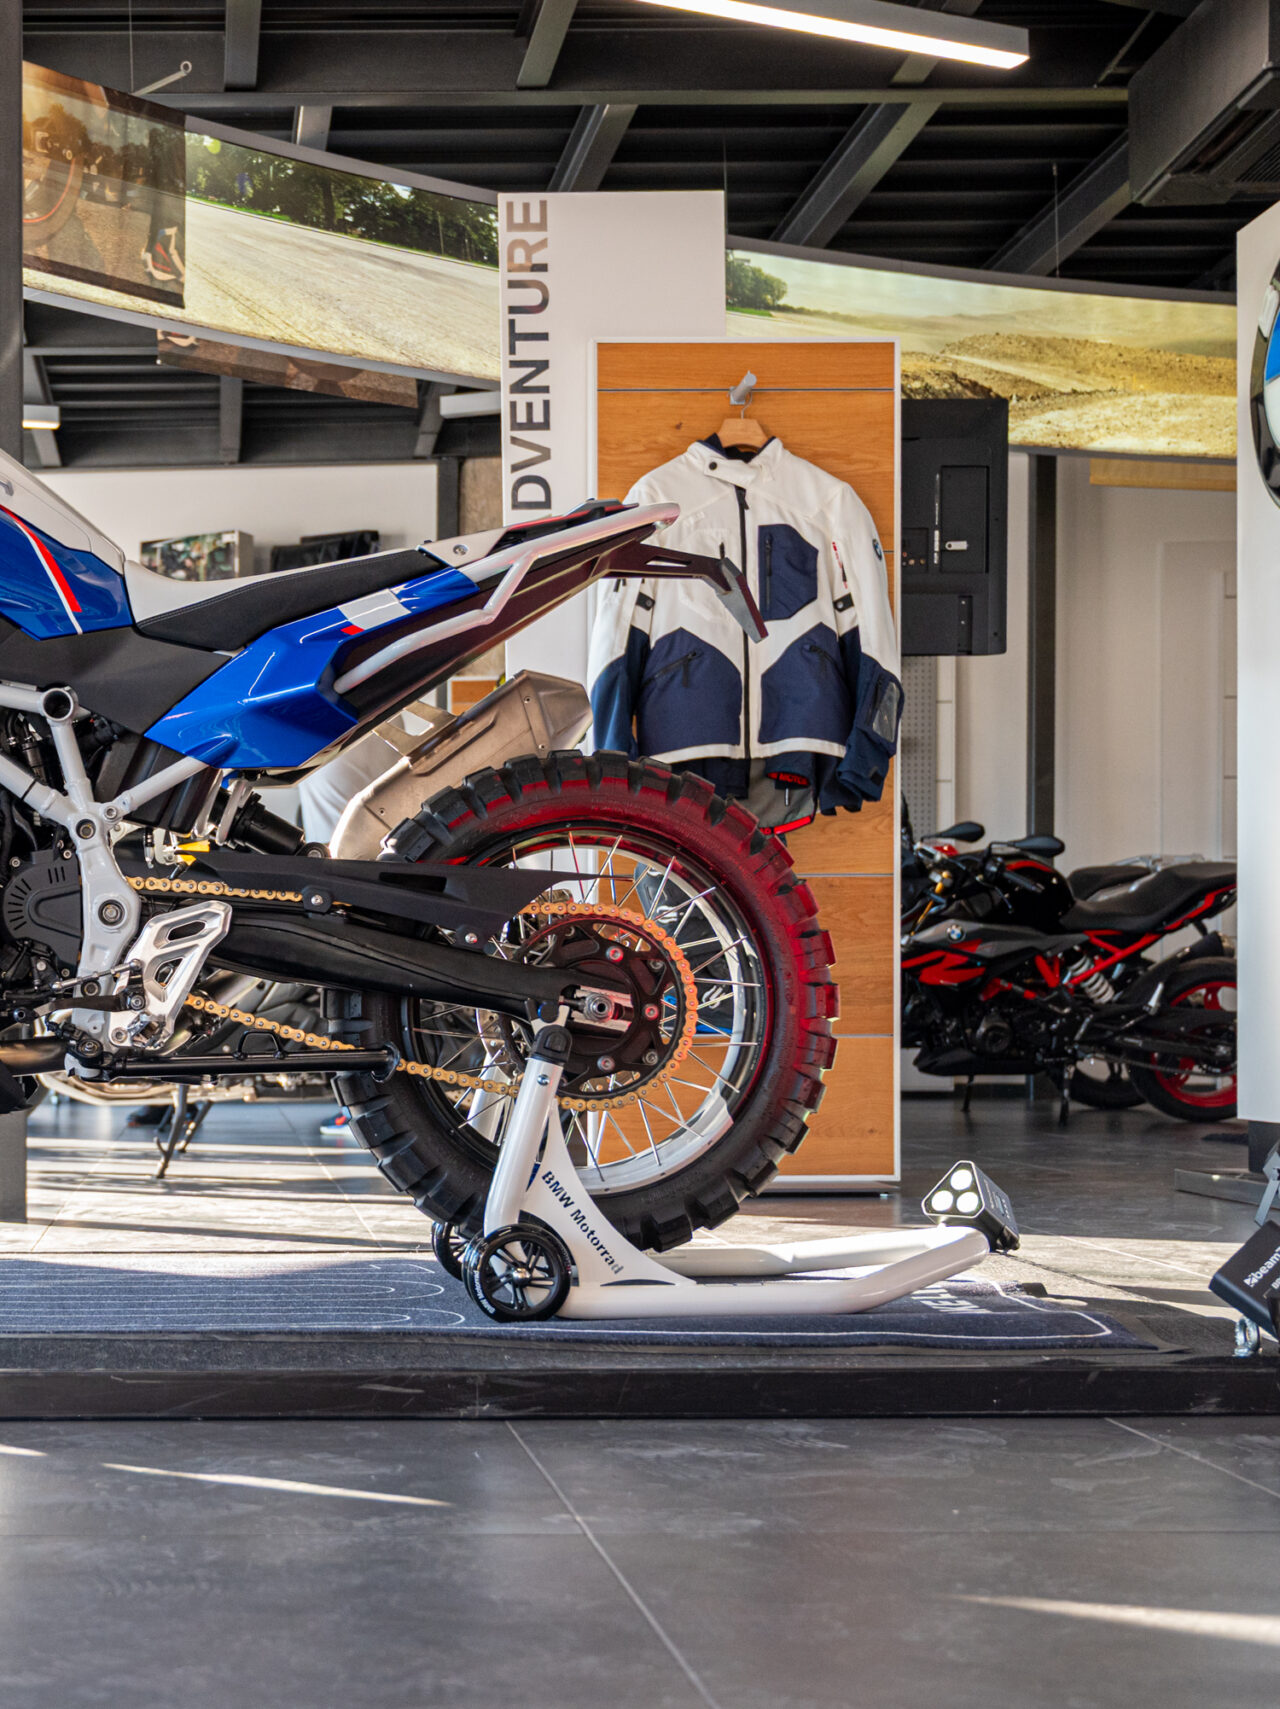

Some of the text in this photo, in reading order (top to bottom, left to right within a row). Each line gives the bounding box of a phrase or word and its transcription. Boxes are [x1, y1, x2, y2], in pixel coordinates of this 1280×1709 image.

[505, 199, 553, 511] DVENTURE
[542, 1171, 624, 1275] BMW Motorrad
